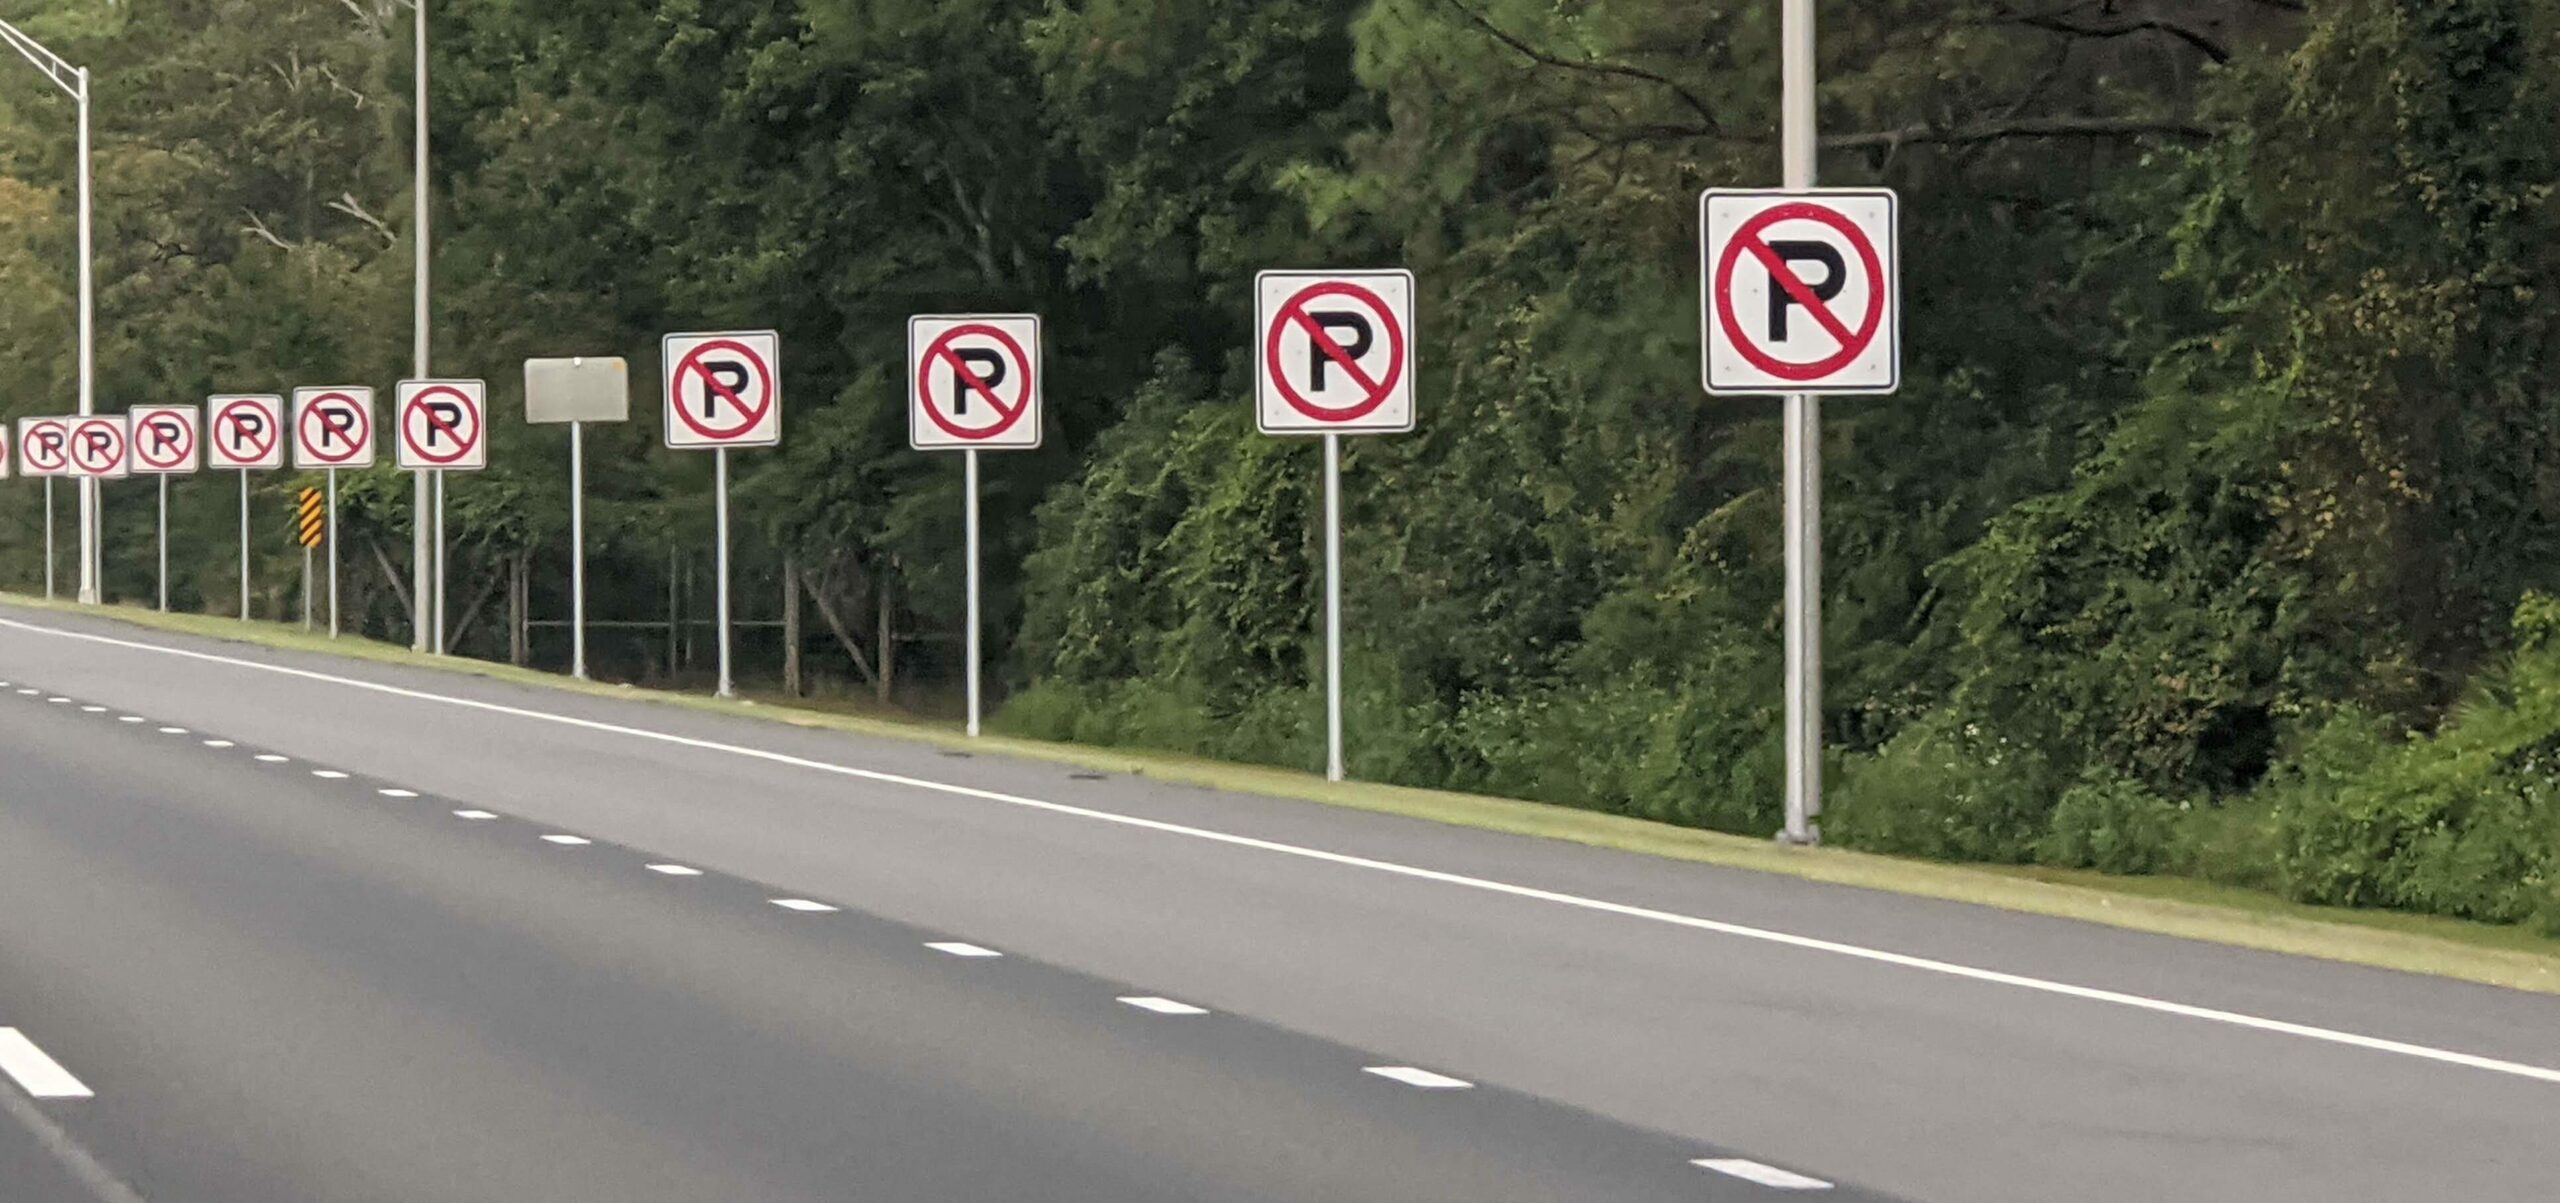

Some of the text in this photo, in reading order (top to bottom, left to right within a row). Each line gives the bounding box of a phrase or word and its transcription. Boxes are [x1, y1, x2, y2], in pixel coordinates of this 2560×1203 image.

[1769, 241, 1846, 342] P
[1310, 312, 1373, 391] P
[703, 361, 748, 417] P
[954, 348, 1005, 415] P
[153, 422, 180, 455] P
[234, 413, 262, 450] P
[322, 408, 355, 446] P
[426, 403, 461, 447] P
[41, 432, 63, 460] P
[88, 431, 112, 462] P
